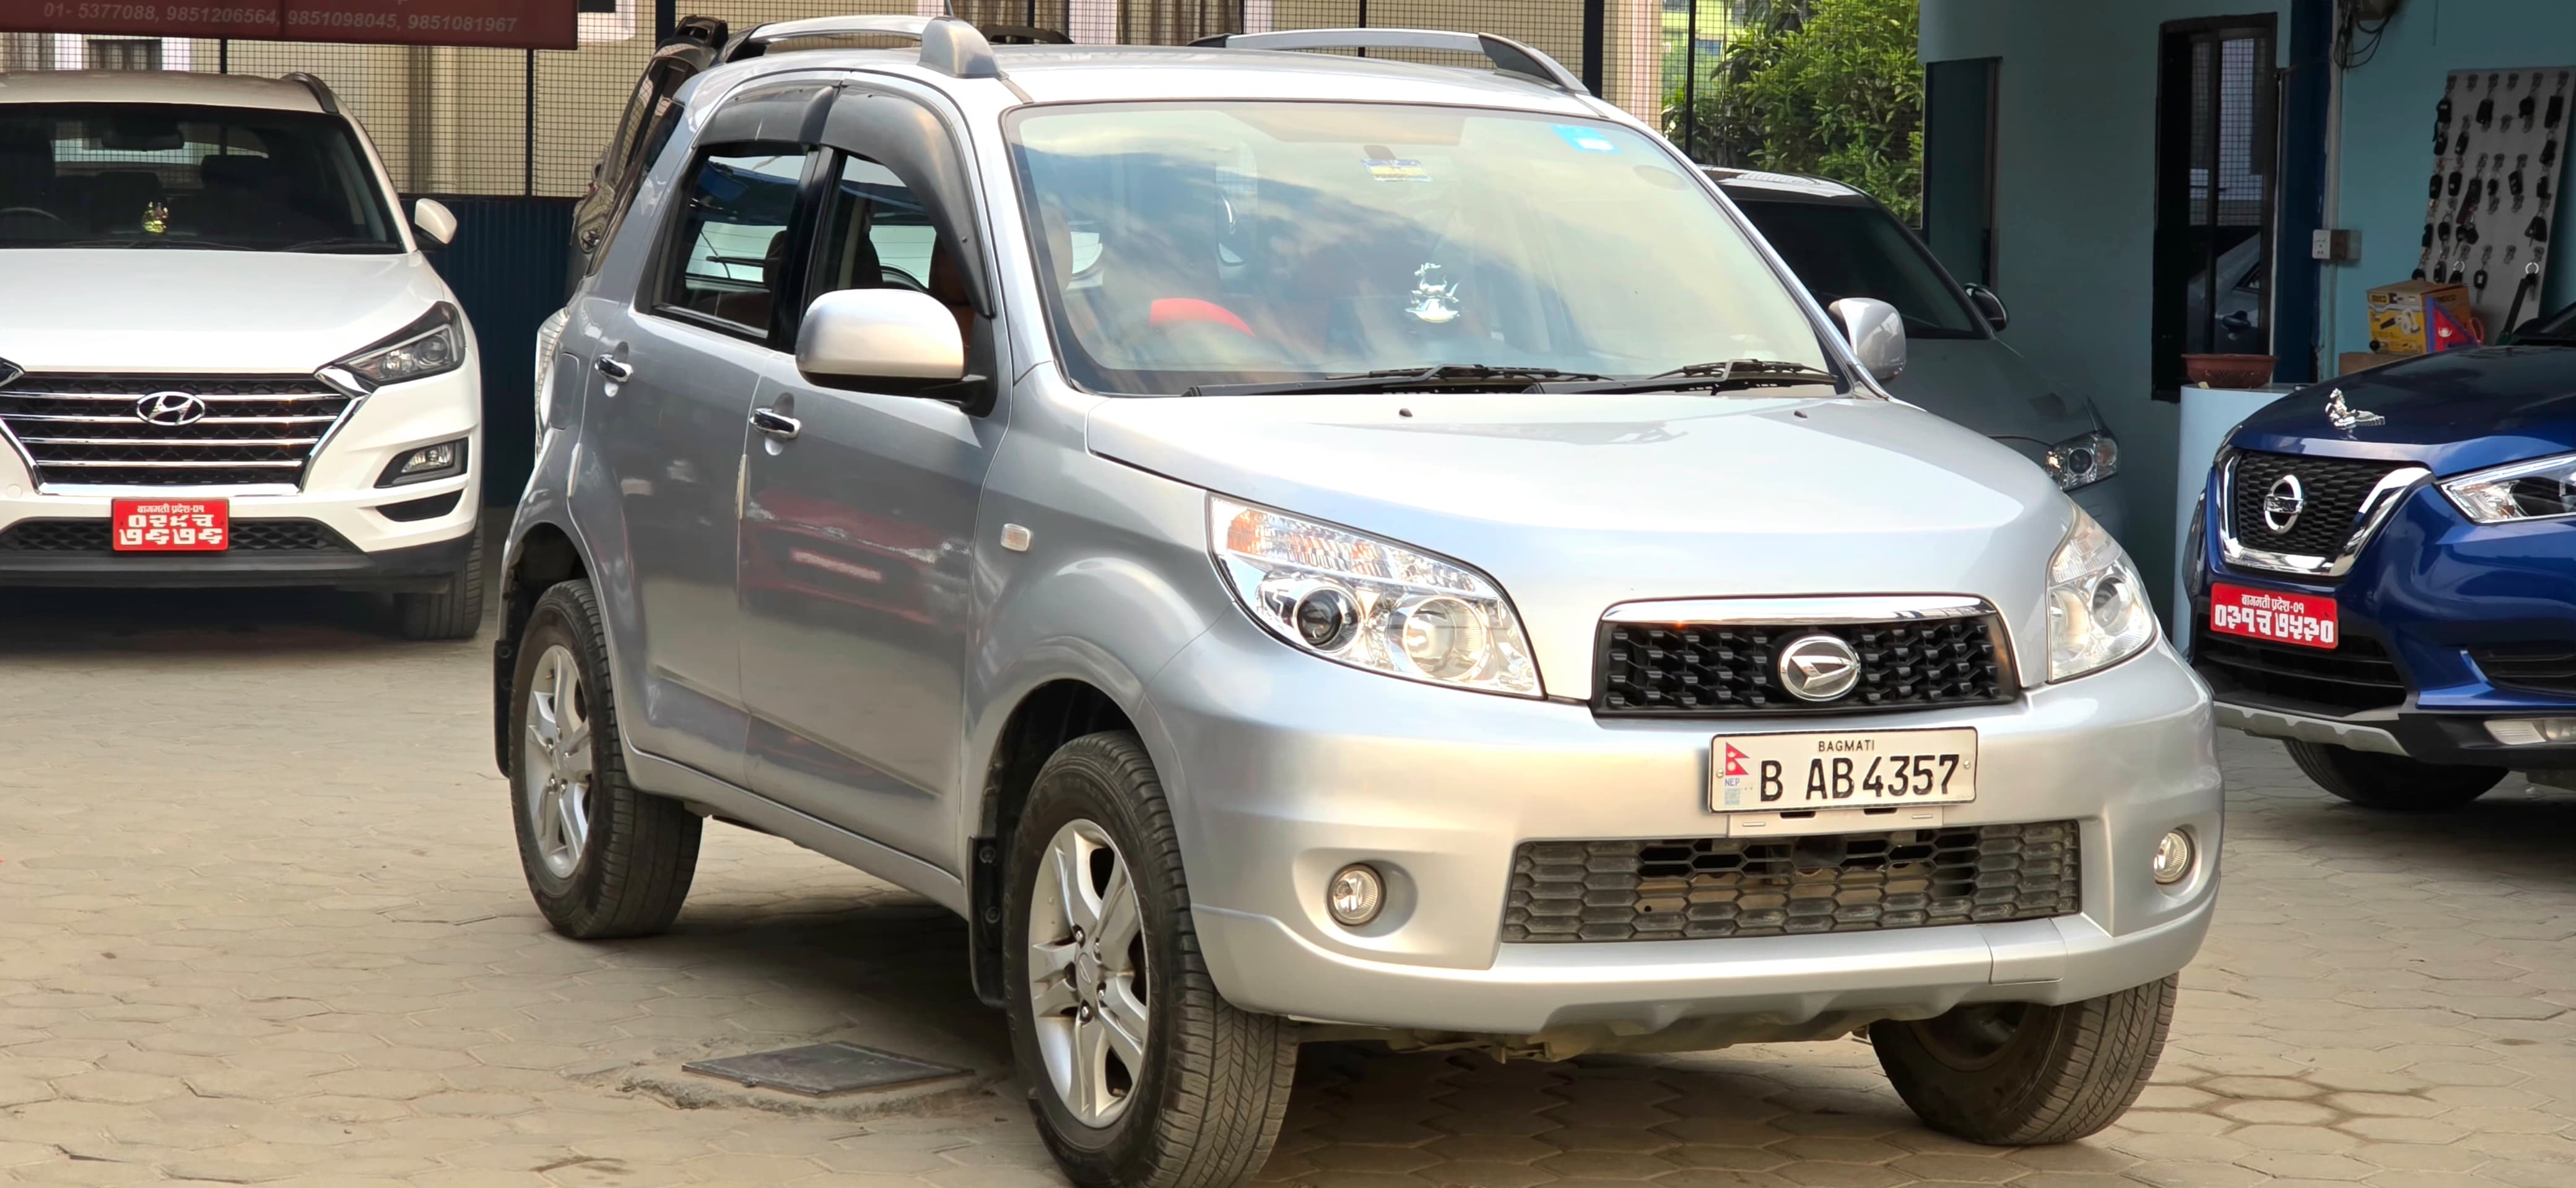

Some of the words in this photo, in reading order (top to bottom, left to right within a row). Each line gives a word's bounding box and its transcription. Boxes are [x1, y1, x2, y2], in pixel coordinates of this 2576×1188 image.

[44, 2, 72, 17] 01-
[77, 3, 159, 24] 5377088,
[166, 5, 281, 27] 9851206564,
[288, 9, 401, 32] 9851098045,
[407, 14, 518, 32] 9851081967
[2241, 594, 2270, 609] बागमती
[2275, 612, 2334, 643] ७५३०
[1817, 739, 1875, 753] BAGMATI
[1725, 778, 1740, 787] NEP
[1760, 759, 1784, 802] B
